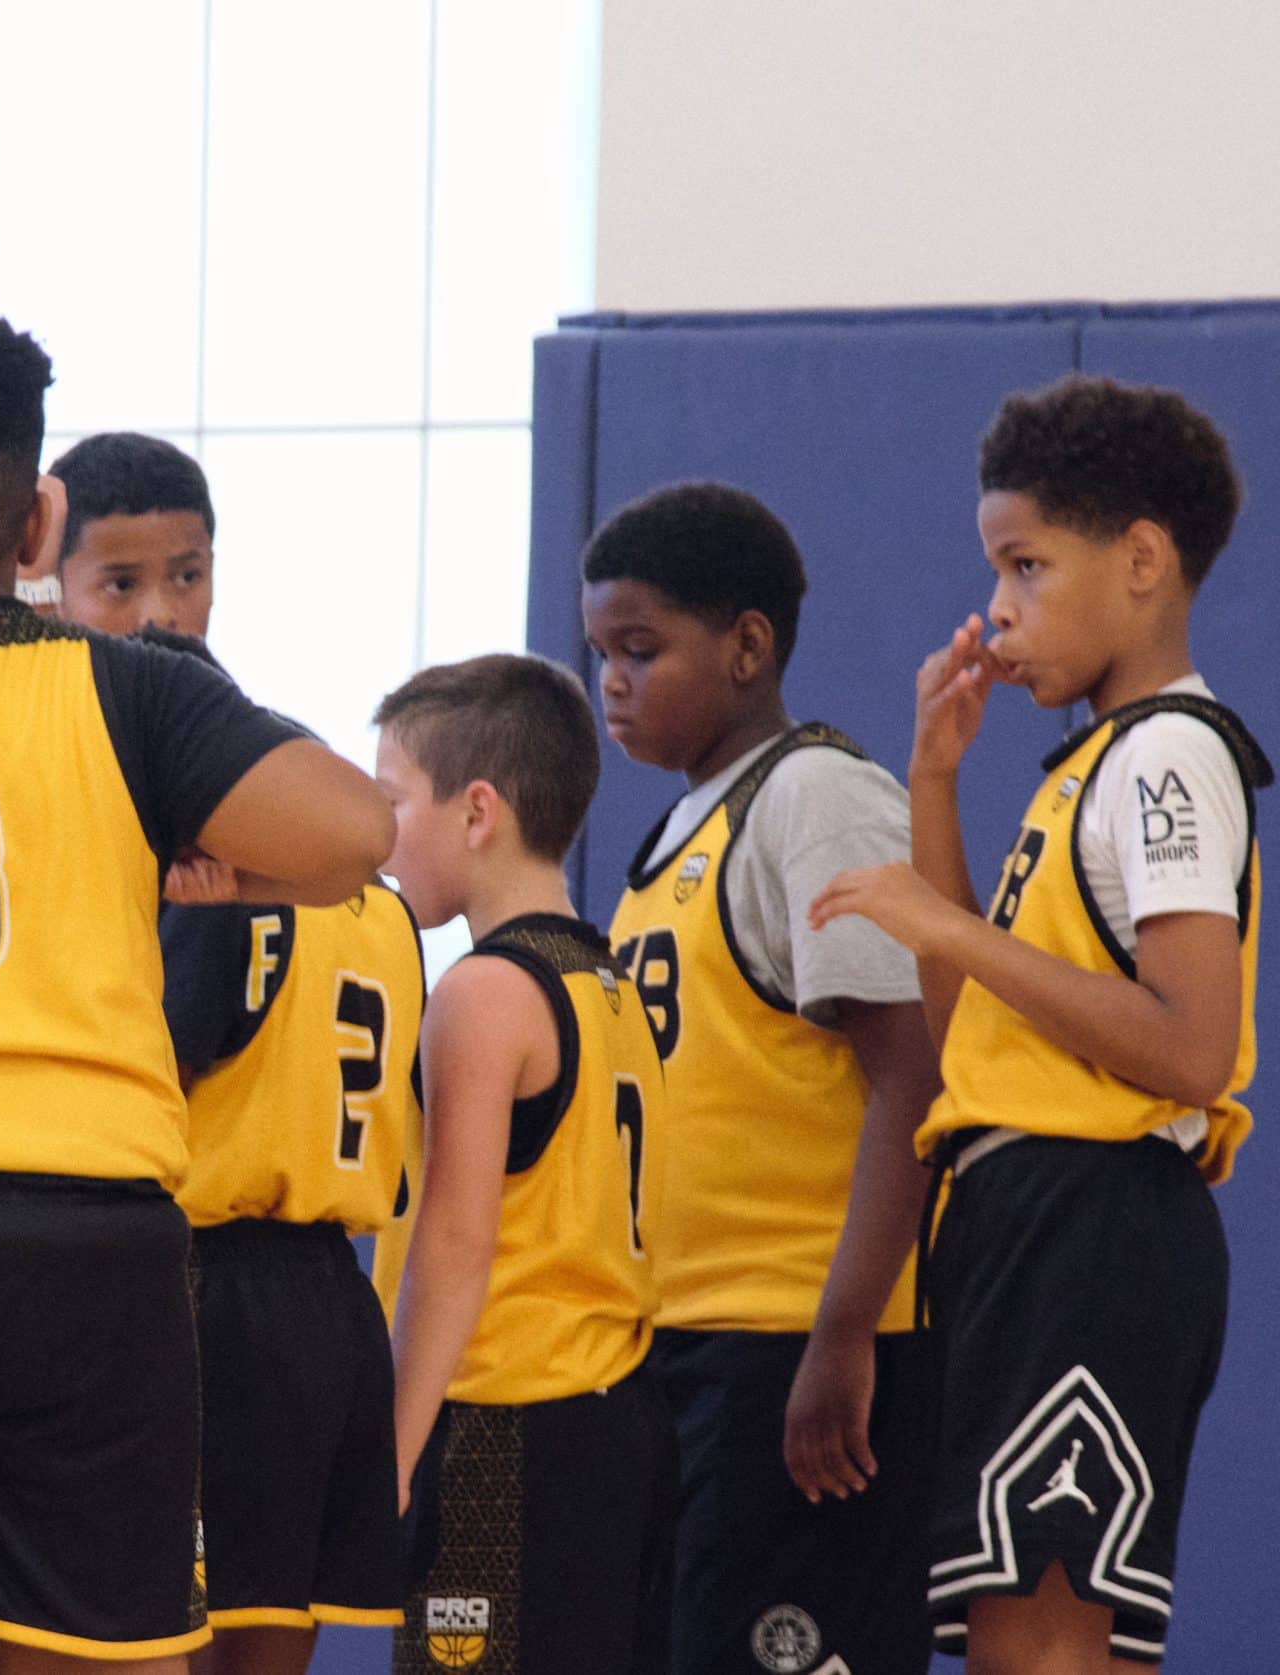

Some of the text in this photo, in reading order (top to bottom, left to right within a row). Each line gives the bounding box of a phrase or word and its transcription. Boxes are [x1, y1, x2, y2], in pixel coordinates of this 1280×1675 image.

[1145, 844, 1199, 865] HOOPS
[426, 1597, 489, 1617] PRO
[426, 1615, 489, 1630] SKILLS
